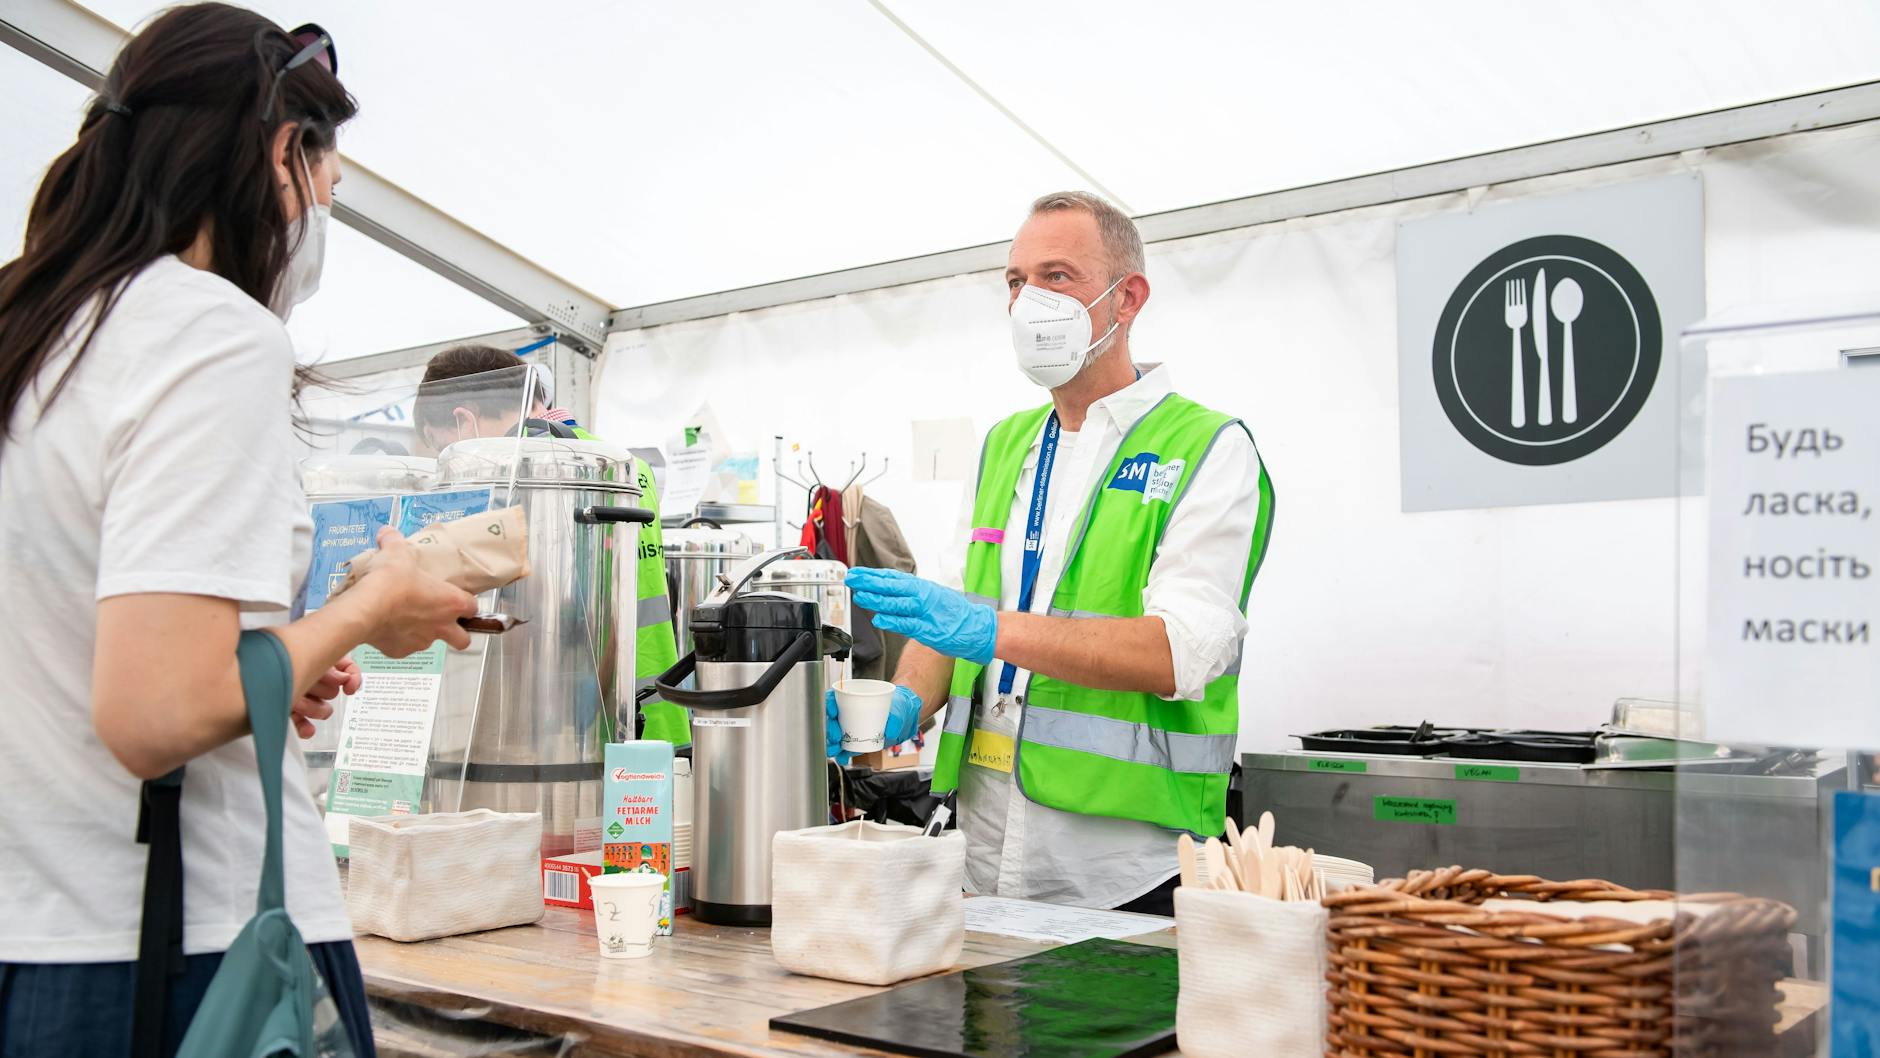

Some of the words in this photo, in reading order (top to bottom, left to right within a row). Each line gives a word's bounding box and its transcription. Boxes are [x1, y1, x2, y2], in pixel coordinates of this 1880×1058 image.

[1746, 422, 1845, 460] Будь
[1741, 489, 1873, 520] ласка,
[1742, 548, 1873, 581] носіть
[1741, 617, 1872, 644] маски
[1464, 769, 1492, 777] VEGAN
[616, 806, 660, 816] FETTARME
[624, 816, 652, 826] MILCH
